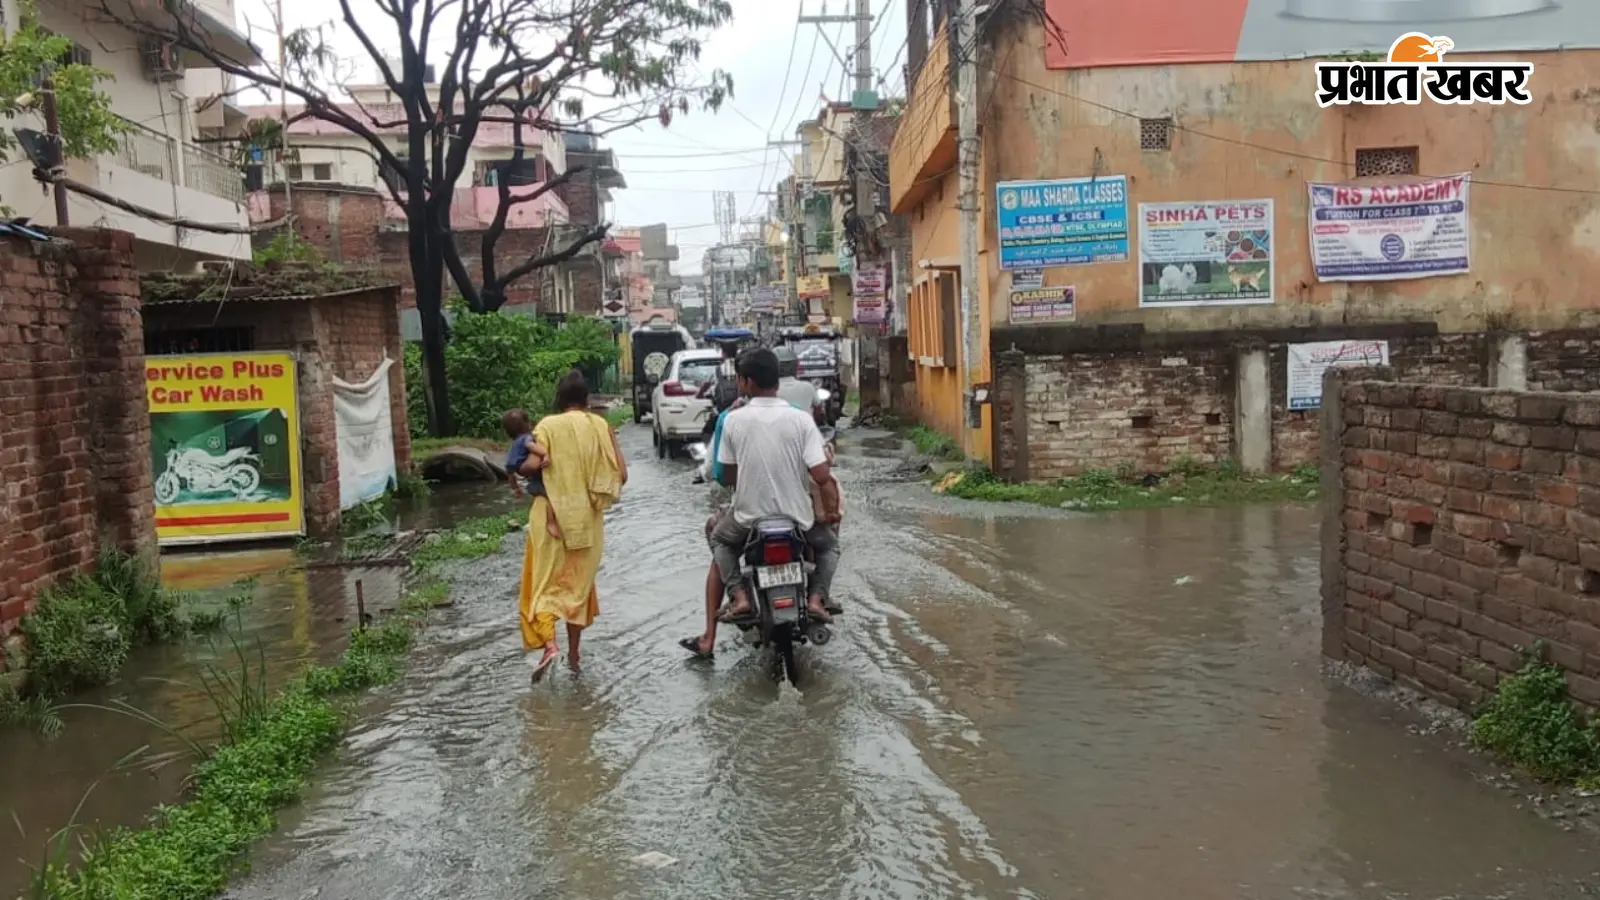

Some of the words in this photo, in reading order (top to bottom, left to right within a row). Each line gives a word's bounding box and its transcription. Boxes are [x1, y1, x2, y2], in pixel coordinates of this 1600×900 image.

[1021, 188, 1040, 208] MAA
[1044, 186, 1081, 207] SHARDA
[1083, 182, 1123, 203] CLASSES
[1336, 187, 1363, 205] RS
[1369, 178, 1463, 204] ACADEMY
[1020, 214, 1054, 224] CBSE
[1058, 212, 1067, 222] &
[1072, 211, 1101, 220] ICSE
[1146, 208, 1208, 222] SINHA
[1215, 205, 1265, 220] PETS
[1362, 207, 1382, 218] FOR
[1383, 206, 1412, 217] CLASS
[146, 363, 224, 381] ervice
[233, 361, 284, 379] Plus
[152, 387, 193, 404] Car
[200, 384, 264, 403] Wash
